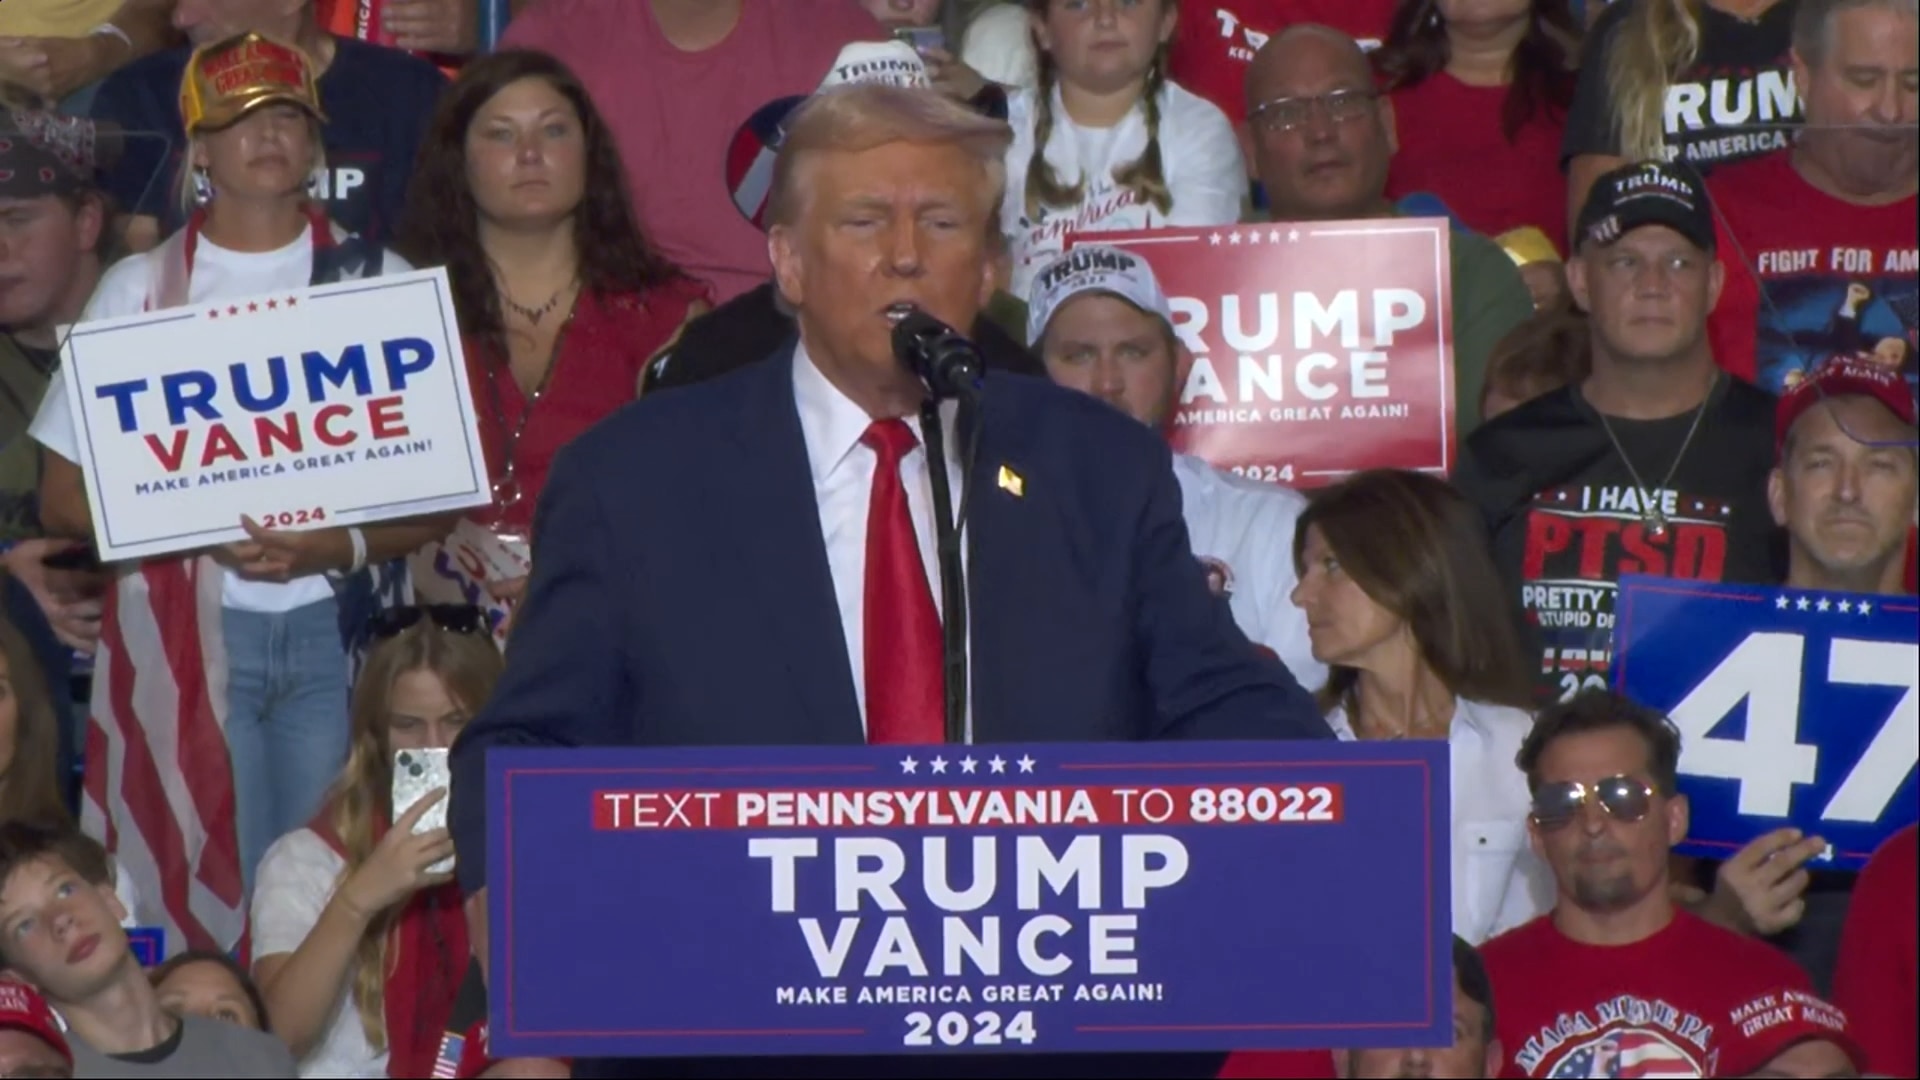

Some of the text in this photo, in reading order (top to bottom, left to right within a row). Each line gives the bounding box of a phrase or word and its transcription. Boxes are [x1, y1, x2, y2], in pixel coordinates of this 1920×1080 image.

[357, 0, 371, 40] RICA
[1664, 70, 1806, 134] RUM
[1686, 130, 1787, 162] AMERICA
[1614, 166, 1694, 196] TRUMP
[1040, 248, 1136, 291] TRUMP
[1758, 247, 1919, 274] FIGHT FOR AM
[1167, 288, 1427, 353] RUMP
[95, 337, 436, 433] TRUMP
[1180, 351, 1390, 405] ANCE
[143, 395, 410, 473] VANCE
[1174, 403, 1410, 425] AMERICA GREAT AGAIN!
[135, 439, 434, 496] MAKE AMERICA GREAT AGAIN!
[262, 506, 327, 529] 2024
[1582, 485, 1679, 514] I HAVE
[1522, 509, 1727, 583] PTSD
[1522, 585, 1605, 611] PRETTY
[1536, 610, 1591, 628] STUPID
[1664, 632, 1919, 823] 47
[604, 786, 1334, 828] TEXT PENNSYLVANIA TO 88022
[747, 834, 1190, 913] TRUMP
[797, 914, 1139, 978] VANCE
[775, 983, 1164, 1005] MAKE AMERICA GREAT AGAIN!
[1730, 994, 1776, 1026] MAKE
[903, 1009, 1037, 1047] 2024
[1742, 1005, 1845, 1038] GREAT AGAIN
[1515, 1012, 1596, 1077] MAGA
